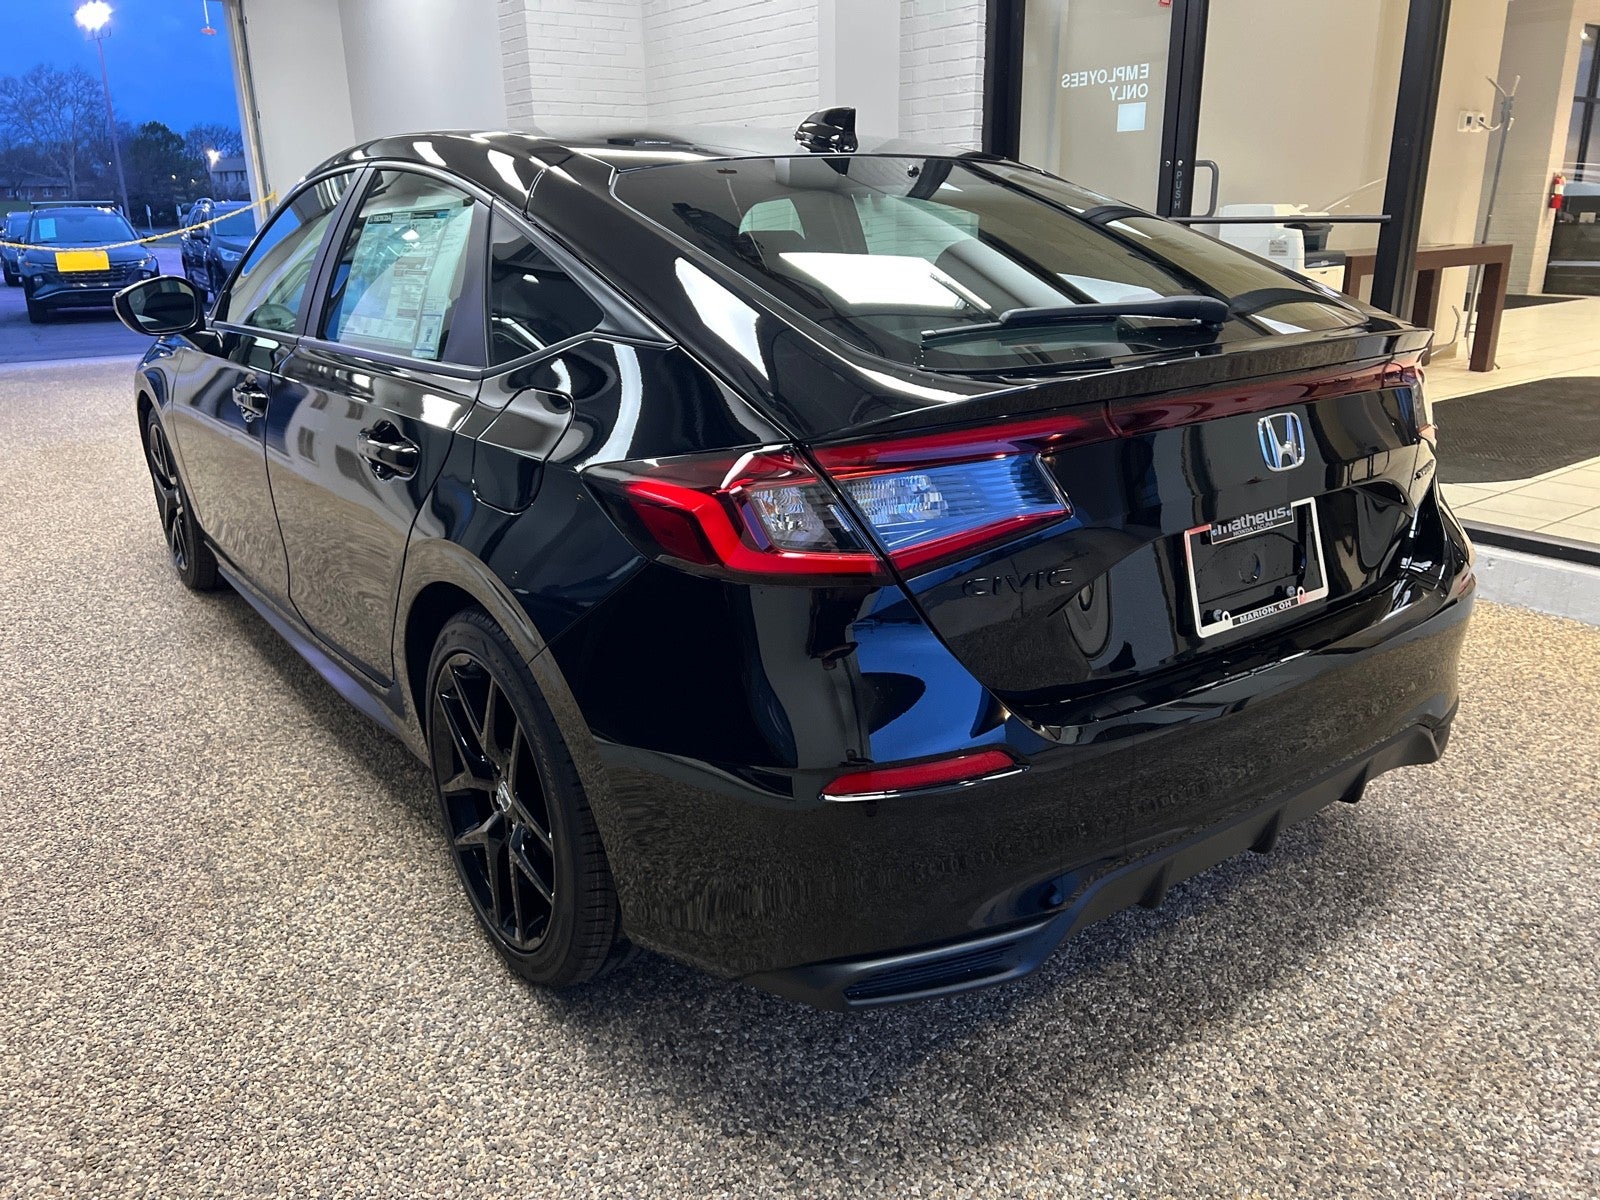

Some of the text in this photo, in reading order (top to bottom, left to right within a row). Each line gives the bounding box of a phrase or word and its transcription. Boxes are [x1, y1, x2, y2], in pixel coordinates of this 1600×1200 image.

[1173, 170, 1183, 209] PUSH
[1216, 506, 1287, 535] mathews
[962, 567, 1073, 597] CIVIC
[1239, 600, 1292, 623] MARION, OH
